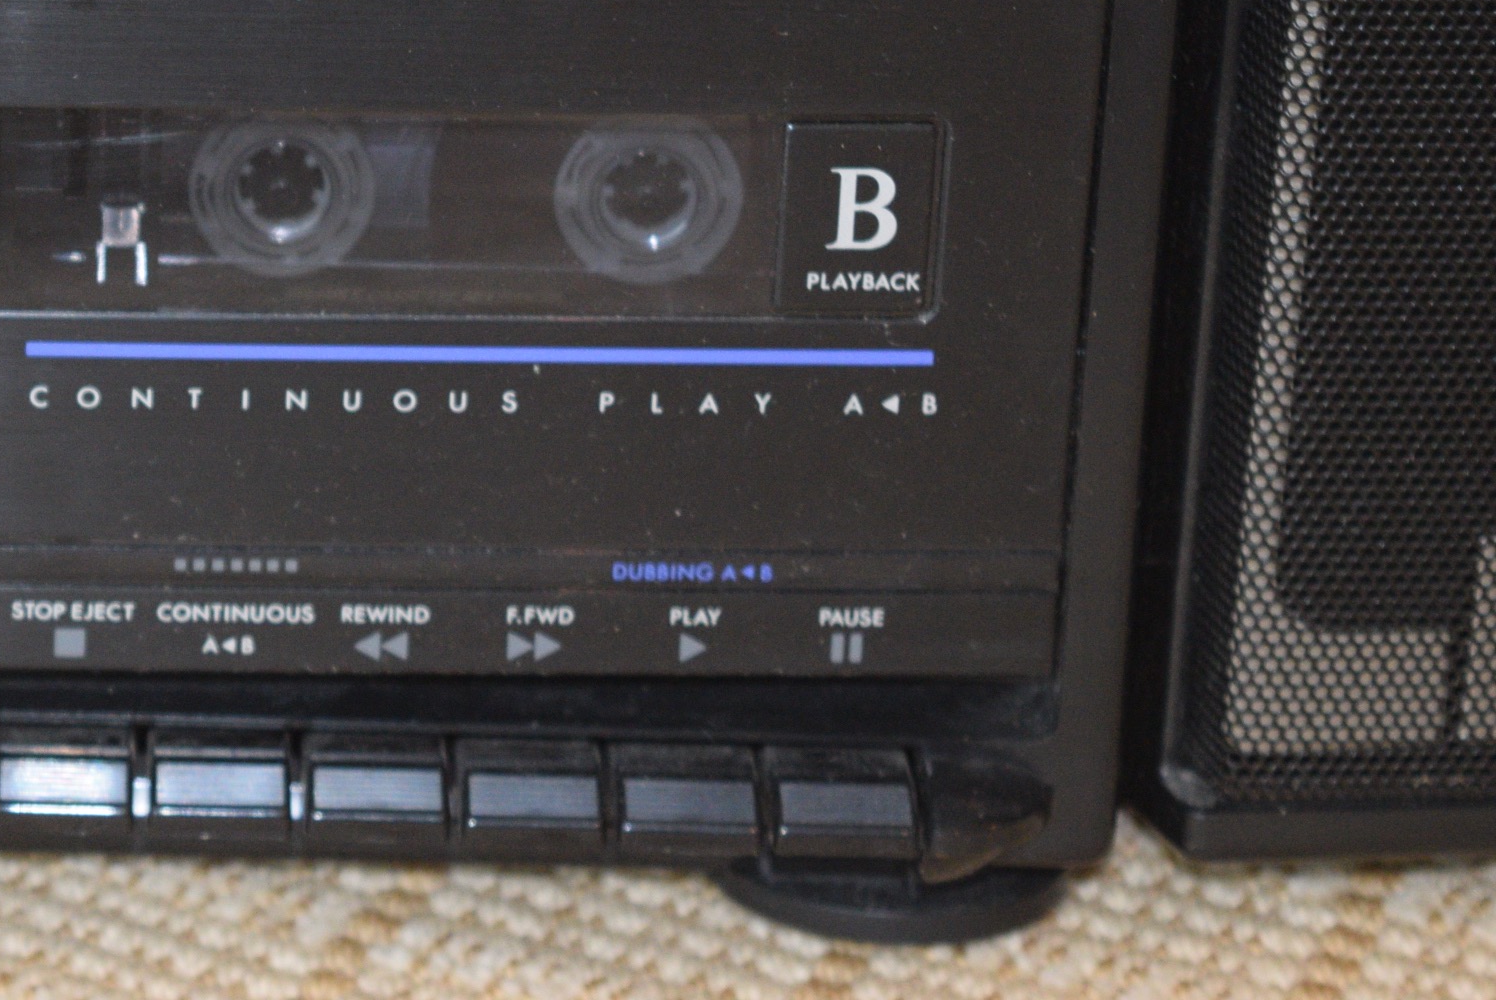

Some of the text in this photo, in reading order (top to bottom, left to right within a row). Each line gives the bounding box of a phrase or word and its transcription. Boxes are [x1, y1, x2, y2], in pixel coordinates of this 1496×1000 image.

[826, 167, 898, 251] B
[806, 272, 920, 292] PLAYBACK
[28, 384, 518, 414] CONTINUOUS
[598, 391, 771, 415] PLAY
[611, 562, 714, 582] DUBBING
[11, 600, 135, 622] STOP EJECT
[156, 602, 315, 624] CONTINUOUS
[340, 604, 431, 624] REWIND
[506, 605, 575, 626] F.FWD
[669, 607, 721, 626] PLAY
[818, 607, 884, 628] PAUSE
